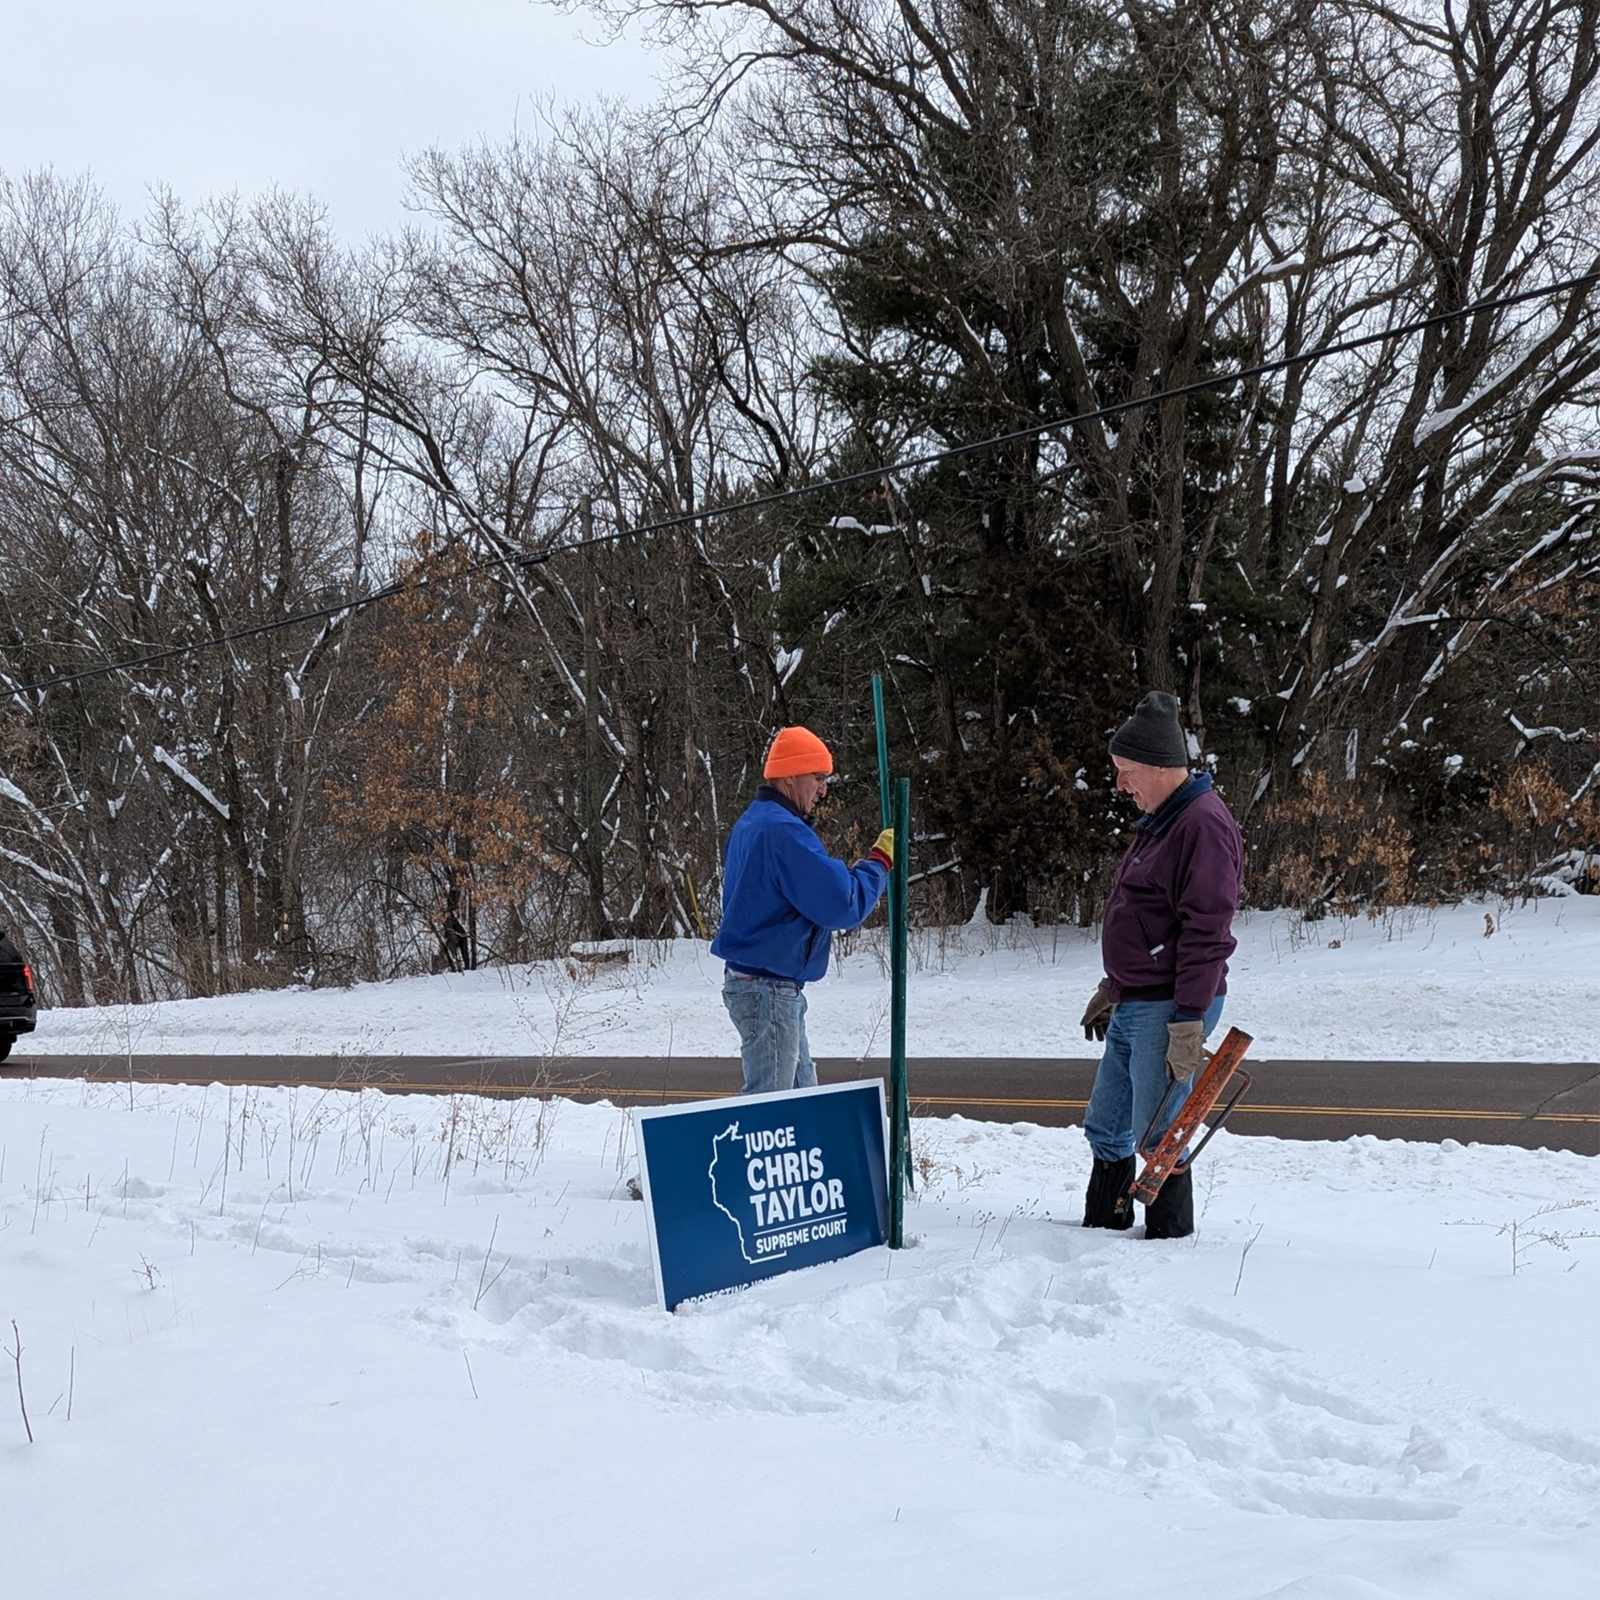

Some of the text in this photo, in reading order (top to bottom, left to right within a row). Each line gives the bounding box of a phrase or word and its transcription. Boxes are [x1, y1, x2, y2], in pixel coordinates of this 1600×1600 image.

[744, 1126, 796, 1159] JUDGE
[747, 1147, 824, 1191] CHRIS
[749, 1178, 845, 1227] TAYLOR
[756, 1218, 847, 1254] SUPREME COURT
